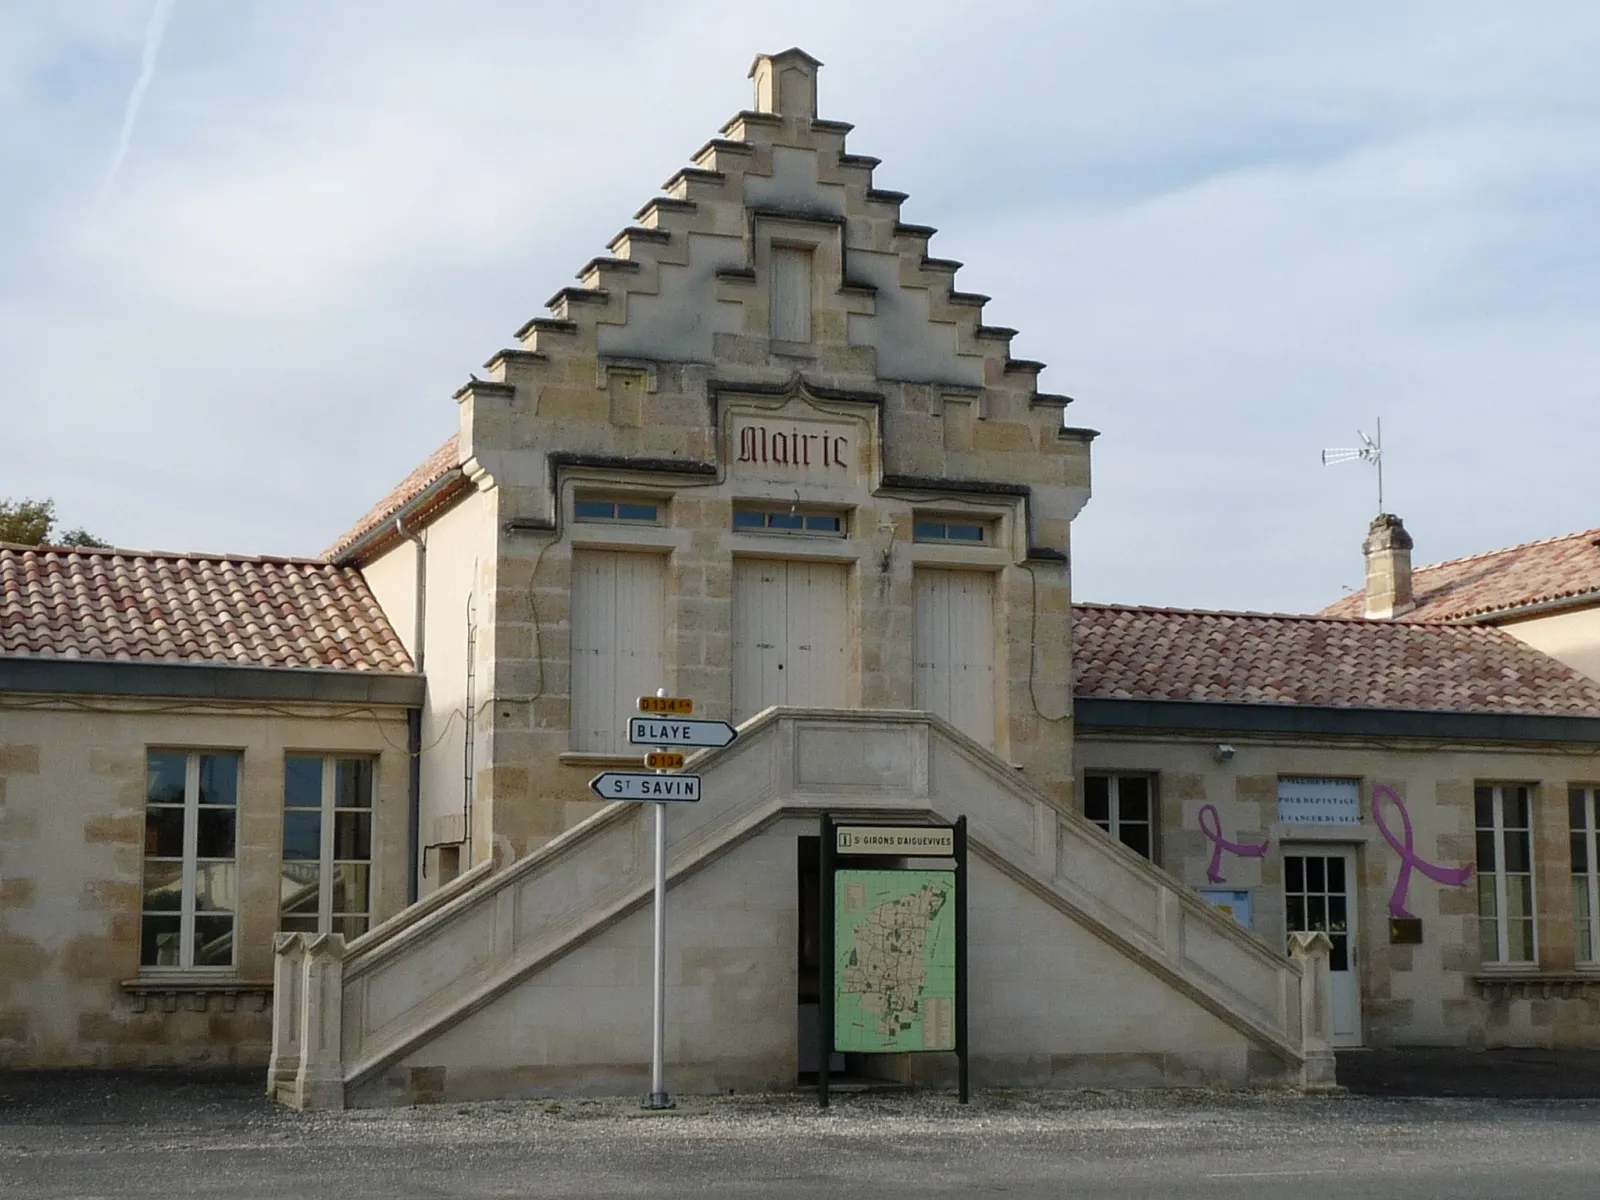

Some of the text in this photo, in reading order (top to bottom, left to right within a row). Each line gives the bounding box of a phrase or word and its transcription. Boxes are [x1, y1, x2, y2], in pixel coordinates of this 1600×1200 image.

[737, 426, 848, 468] Mairie
[637, 724, 691, 739] BLAYE
[641, 781, 694, 795] SAVIN
[863, 835, 894, 845] GIRONS
[897, 836, 951, 846] D'AIGUEVIVES
